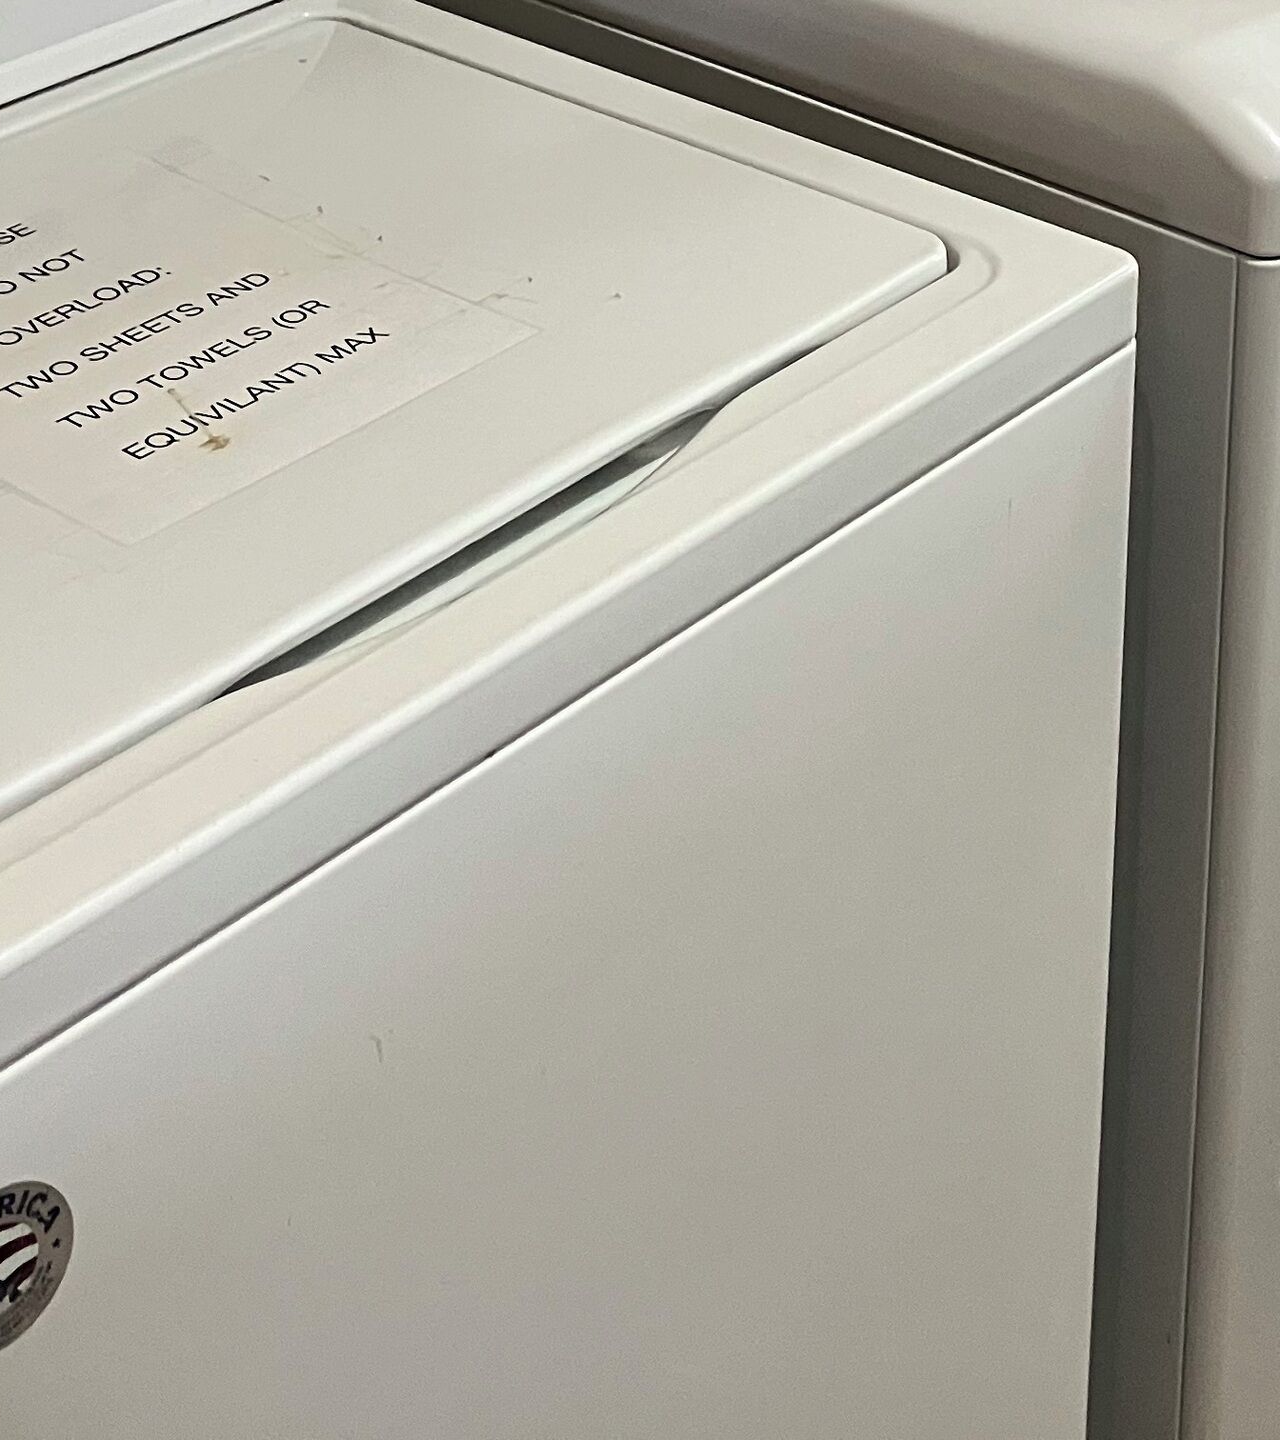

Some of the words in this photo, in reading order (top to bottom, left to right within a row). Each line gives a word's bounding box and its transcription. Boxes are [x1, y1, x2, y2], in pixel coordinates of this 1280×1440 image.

[18, 248, 87, 284] NOT
[79, 302, 205, 362] SHEETS
[205, 272, 271, 307] AND
[314, 326, 391, 364] MAX
[55, 388, 140, 429] TWO
[136, 326, 273, 392] TOWELS
[270, 298, 332, 330] (OR
